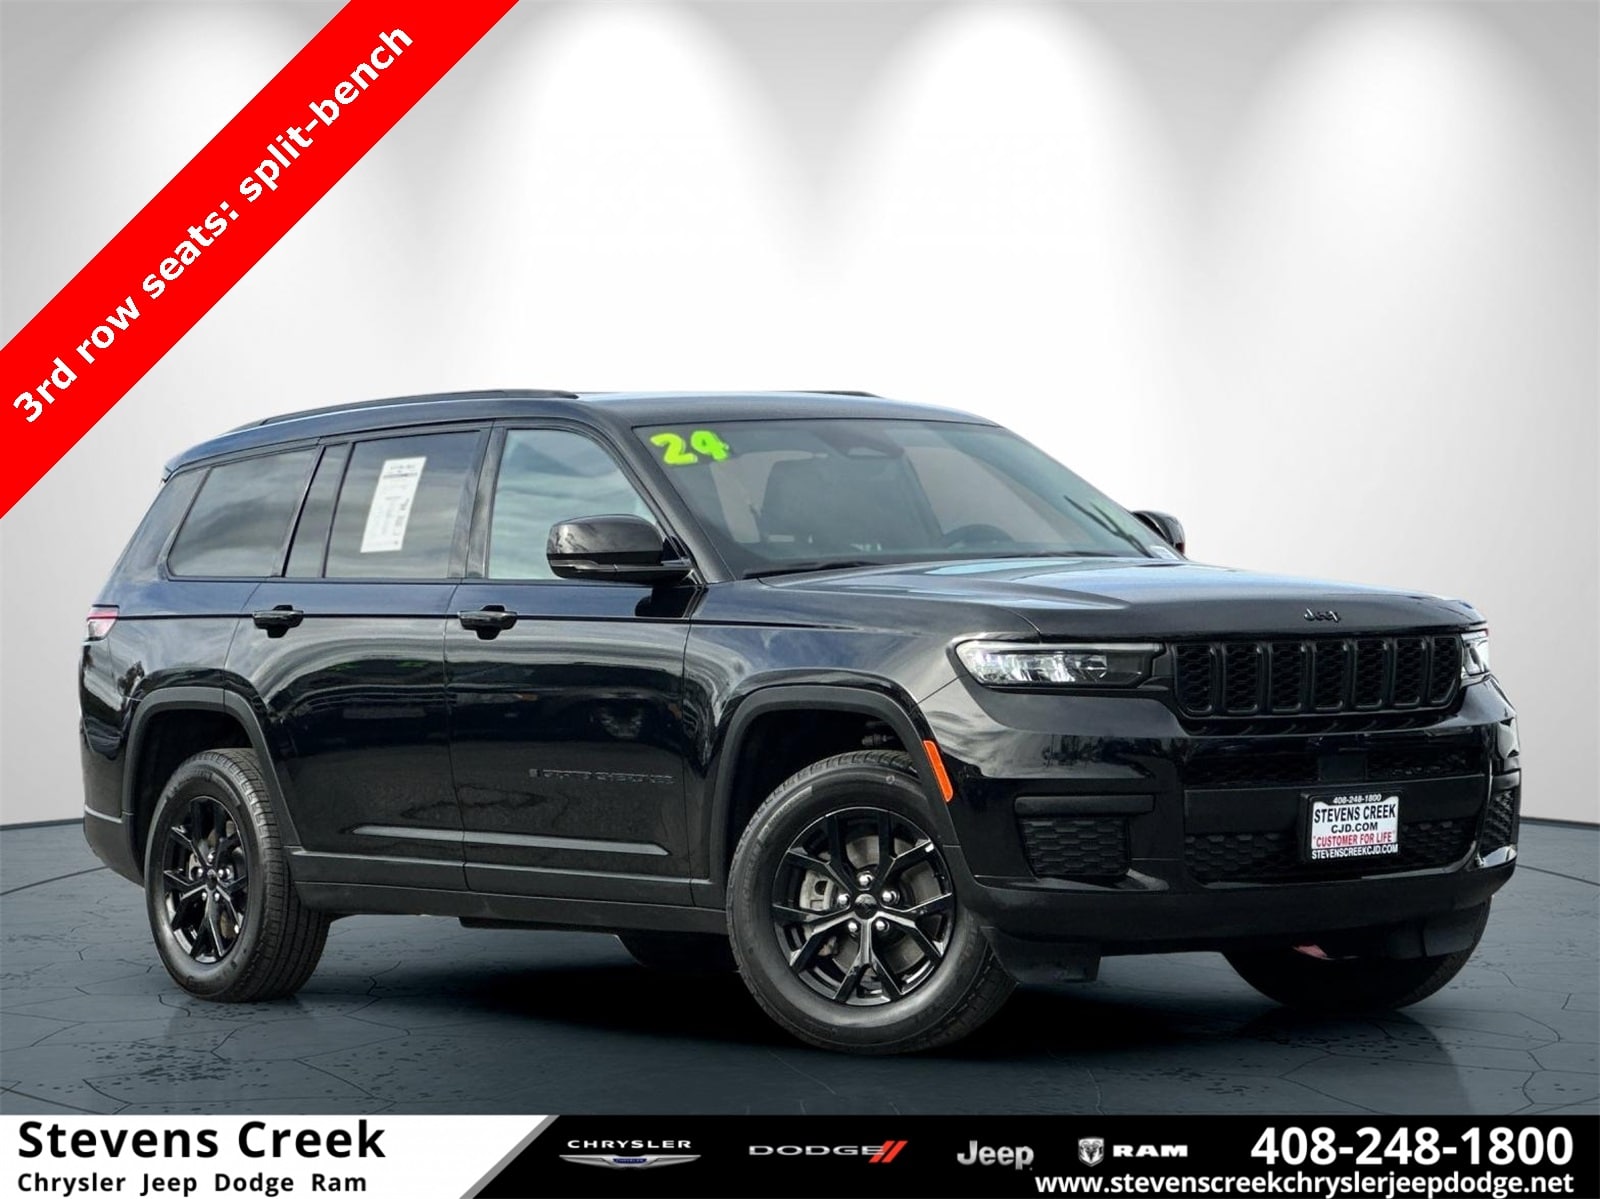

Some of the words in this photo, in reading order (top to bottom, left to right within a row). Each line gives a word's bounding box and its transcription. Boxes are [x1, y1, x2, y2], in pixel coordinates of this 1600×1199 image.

[652, 431, 727, 464] 24
[1333, 794, 1382, 804] 408-248-1800
[1314, 806, 1360, 823] STEVENS
[1363, 804, 1396, 820] CREEK
[1331, 822, 1378, 834] CJD.COM
[1360, 833, 1375, 844] FOR
[1312, 844, 1398, 859] STEVENSCREEKCJD.COM
